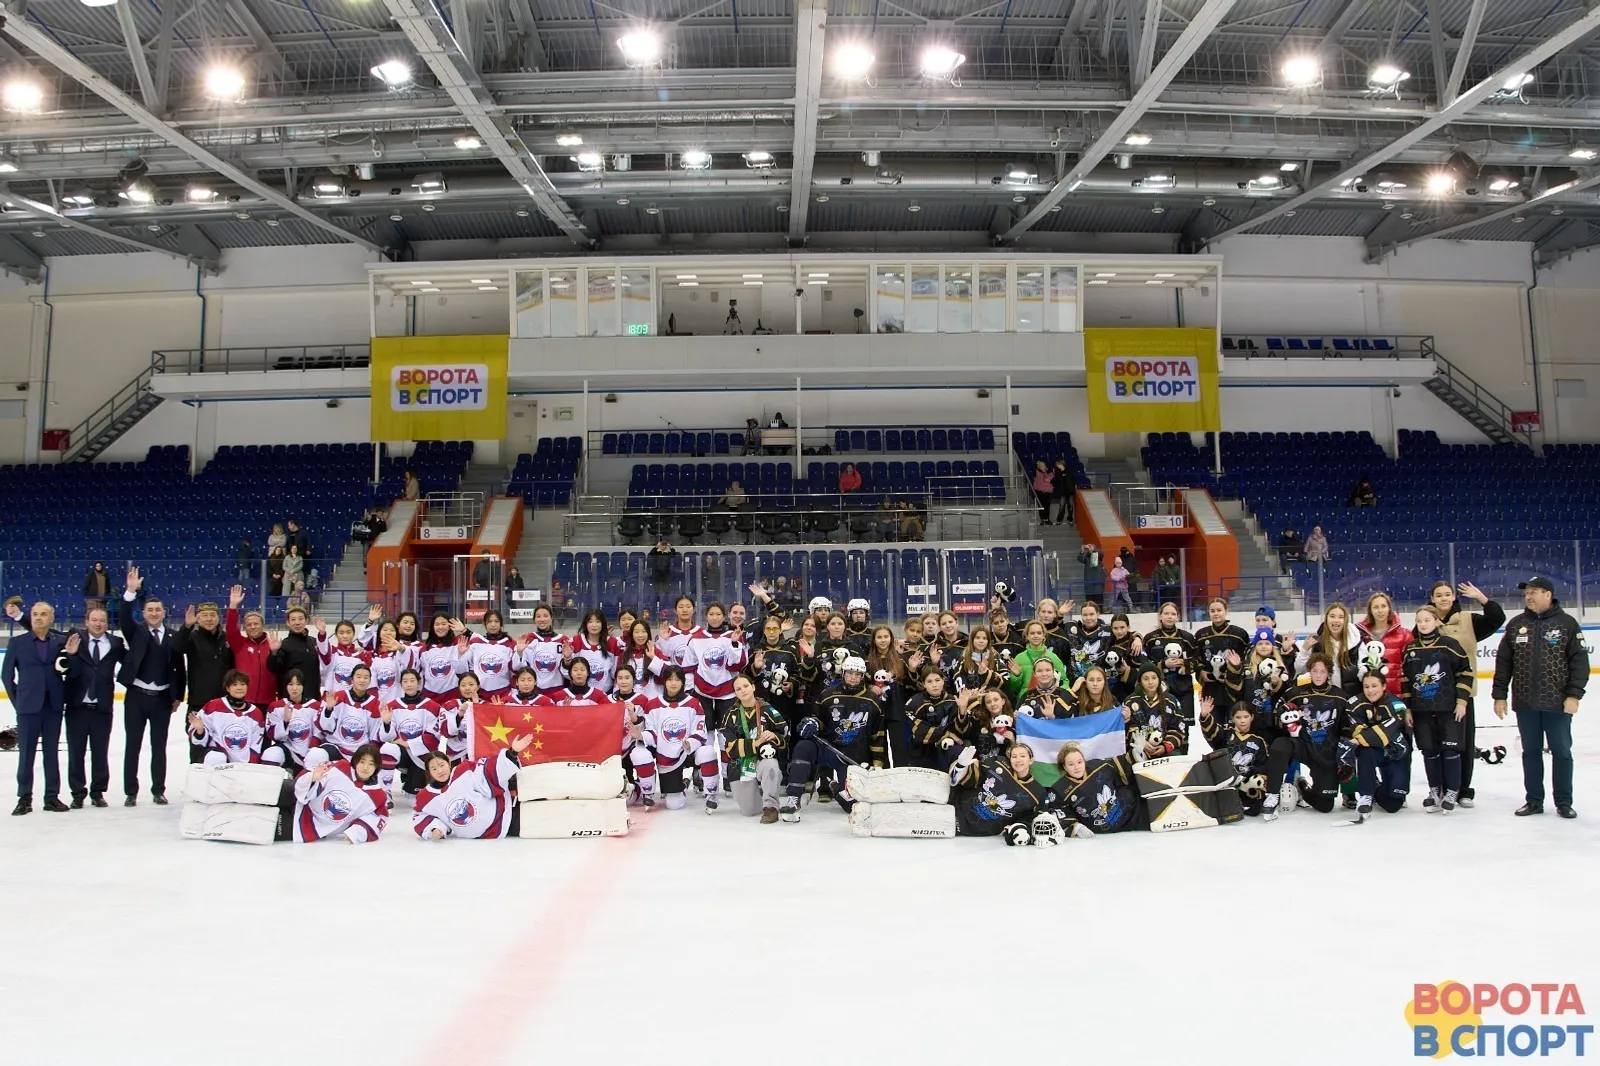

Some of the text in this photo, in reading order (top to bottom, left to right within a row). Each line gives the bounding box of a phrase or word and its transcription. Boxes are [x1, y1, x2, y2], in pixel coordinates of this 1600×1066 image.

[628, 324, 649, 335] 18:03
[1113, 360, 1192, 376] ВОРОТА
[399, 368, 479, 385] ВОРОТА
[1114, 380, 1196, 396] В СПОРТ
[399, 388, 482, 405] В СПОРТ
[1140, 517, 1147, 527] 9
[1169, 516, 1182, 527] 10
[423, 528, 431, 538] 8
[457, 527, 464, 538] 9
[1142, 758, 1170, 768] CCM
[1162, 821, 1189, 829] CCM
